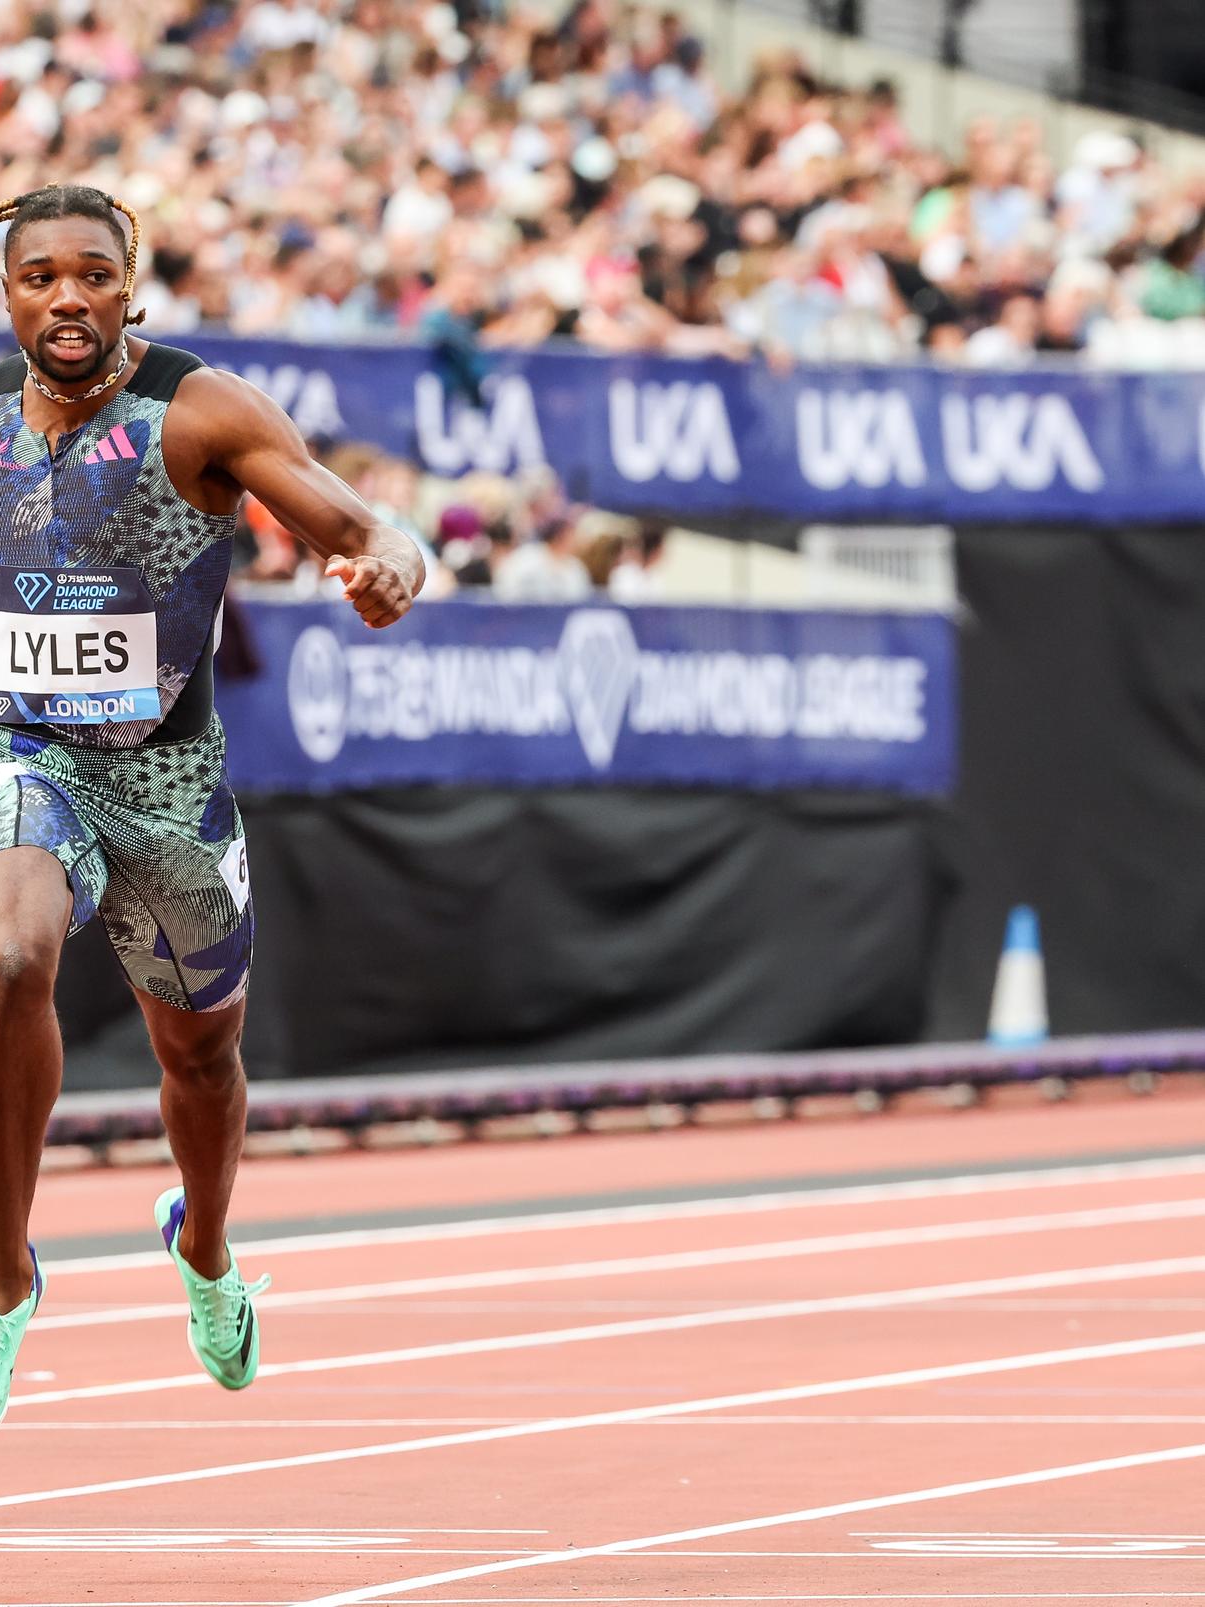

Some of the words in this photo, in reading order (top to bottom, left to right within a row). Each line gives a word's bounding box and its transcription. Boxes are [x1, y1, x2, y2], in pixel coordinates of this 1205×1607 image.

[55, 585, 119, 597] DIAMOND
[52, 598, 105, 610] LEAGUE
[10, 631, 129, 675] LYLES
[44, 696, 135, 718] LONDON
